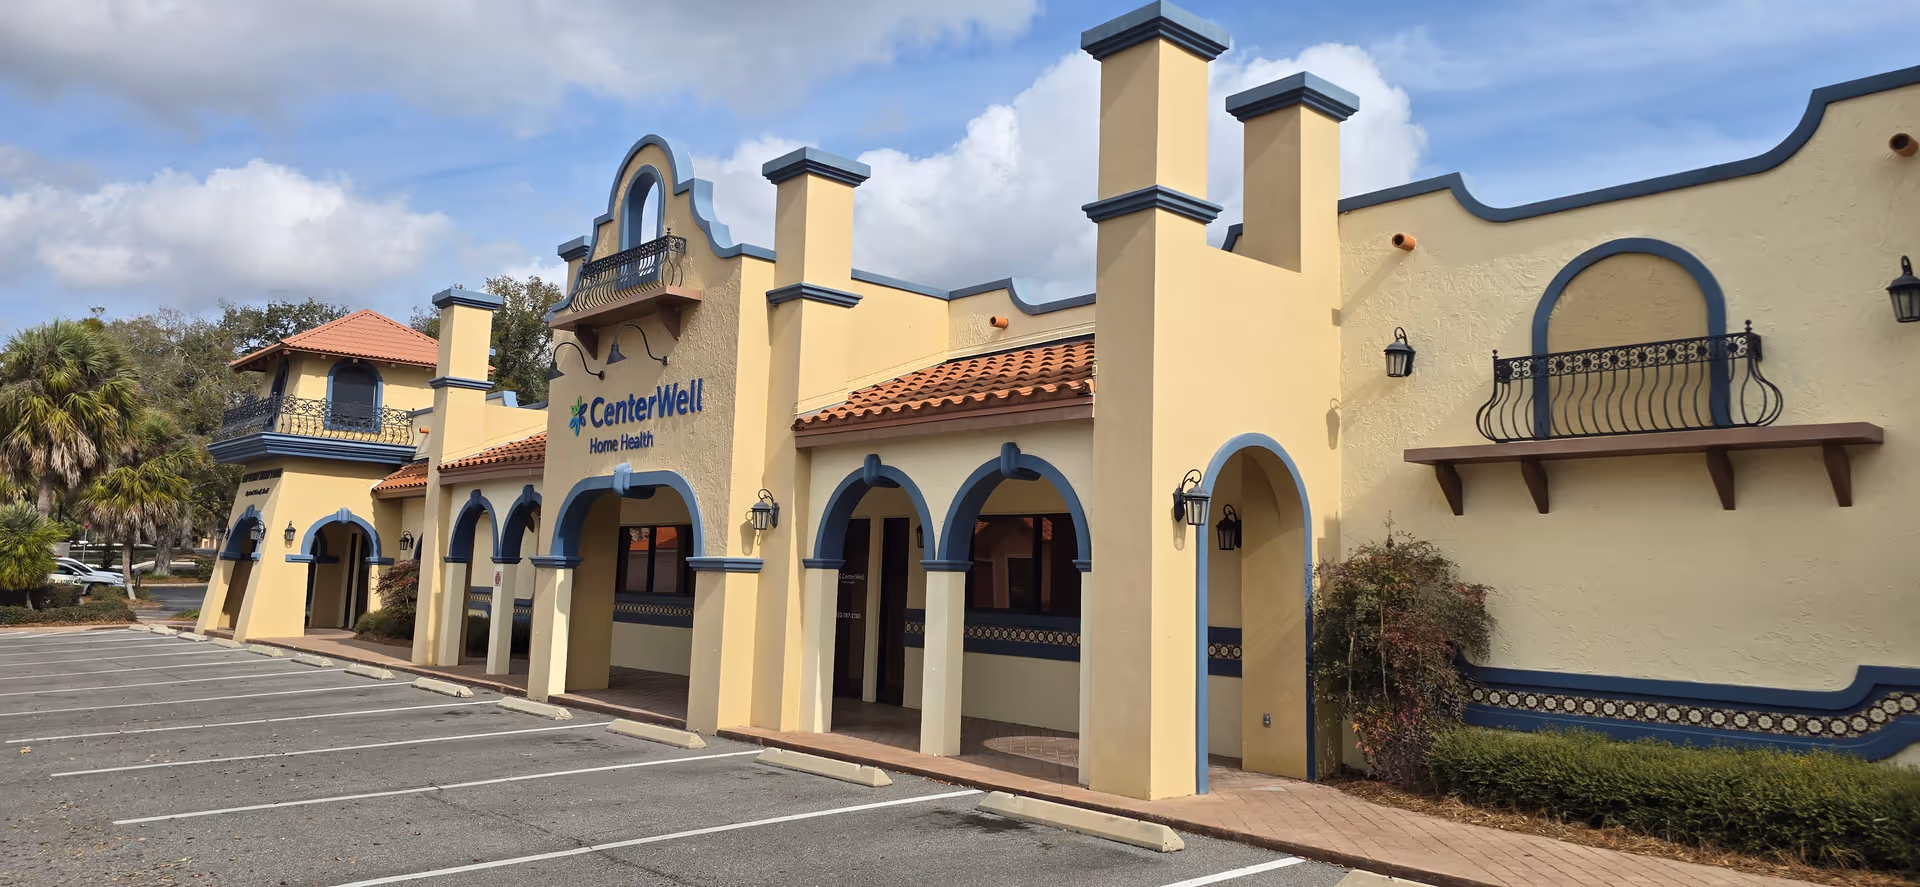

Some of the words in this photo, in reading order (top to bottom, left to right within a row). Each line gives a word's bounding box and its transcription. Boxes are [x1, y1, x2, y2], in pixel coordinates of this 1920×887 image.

[590, 378, 703, 428] CenterWell
[589, 437, 619, 454] Home
[620, 431, 653, 451] Health
